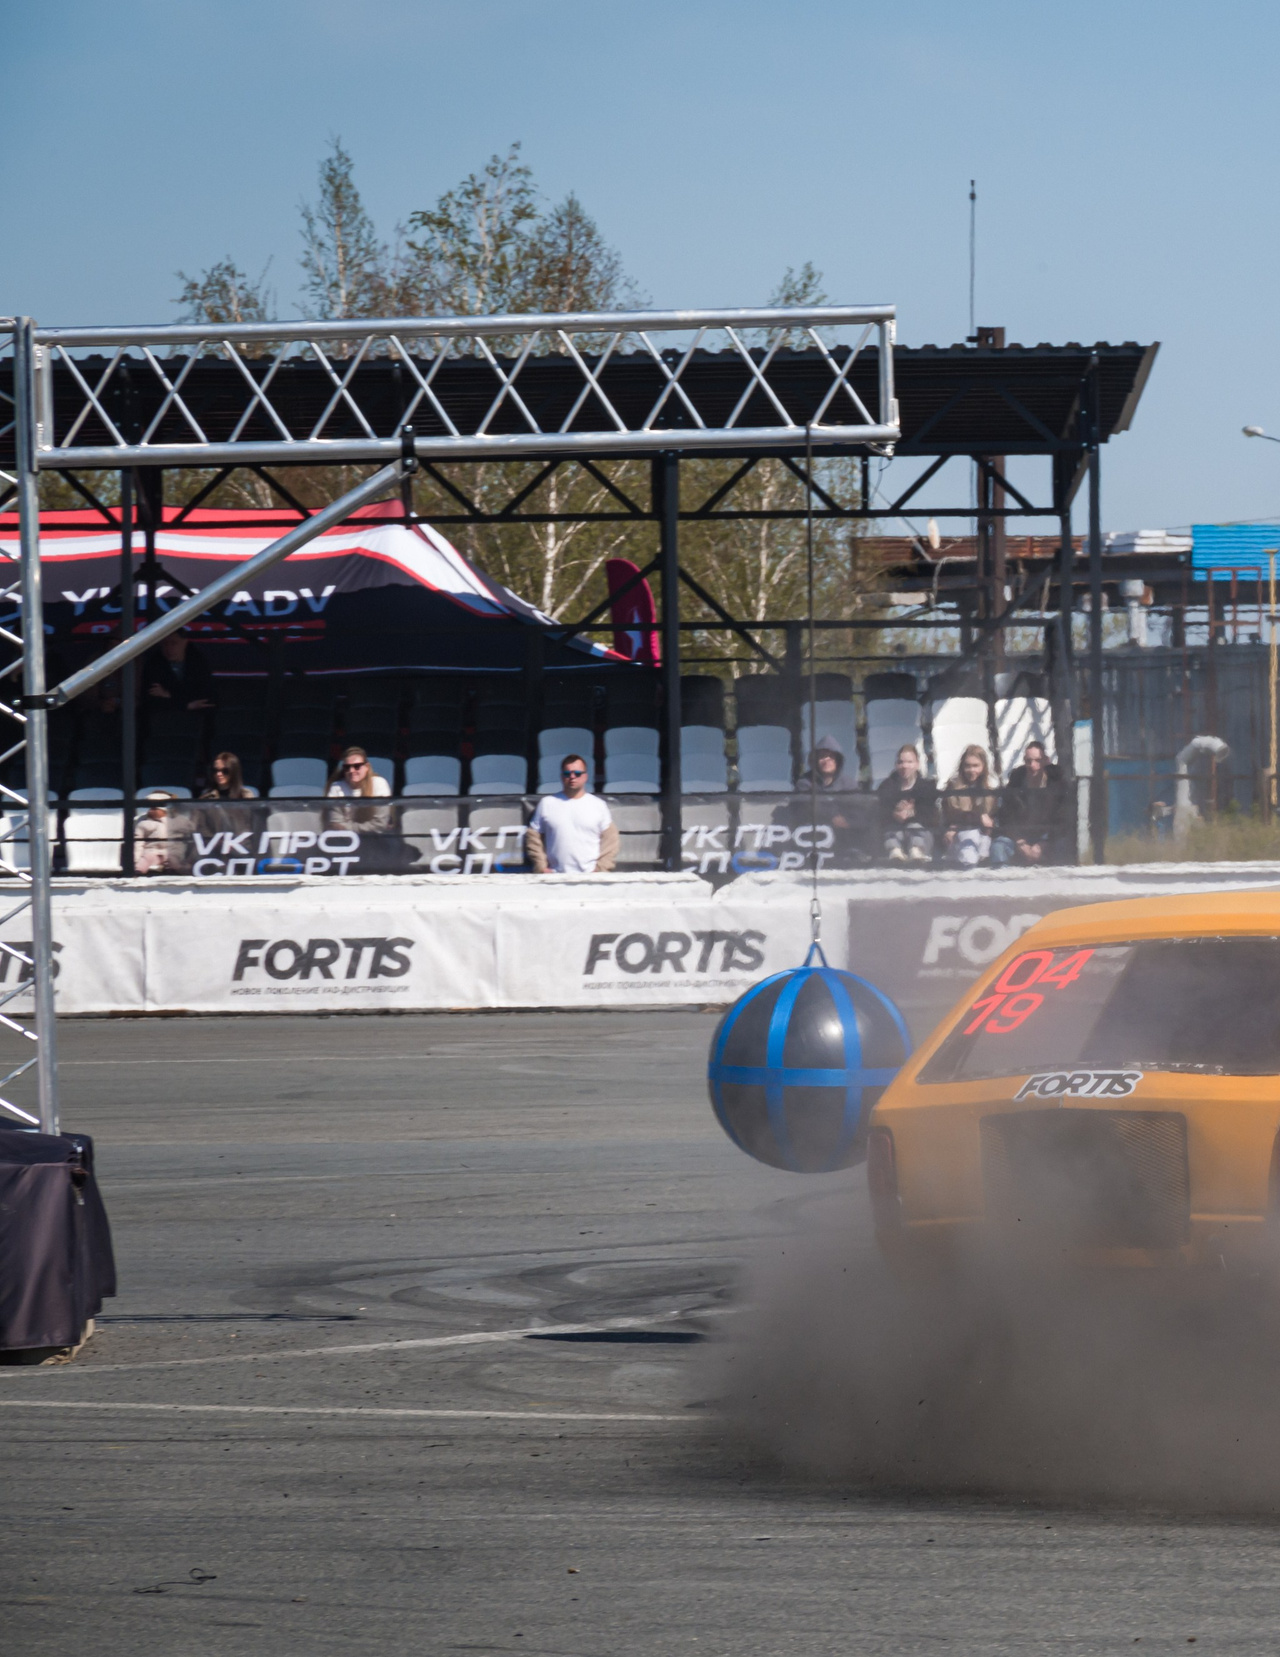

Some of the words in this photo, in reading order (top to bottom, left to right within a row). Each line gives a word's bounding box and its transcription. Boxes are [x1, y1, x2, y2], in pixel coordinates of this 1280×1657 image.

[224, 585, 336, 617] ADV
[192, 831, 253, 855] VK
[258, 830, 360, 854] ПРО
[429, 826, 491, 850] VK
[734, 824, 835, 848] ПРО
[192, 856, 360, 877] СПОРТ
[430, 853, 536, 874] СПО
[232, 937, 415, 981] FORTIS
[583, 930, 766, 975] FORTIS
[995, 949, 1096, 993] 04
[963, 993, 1045, 1035] 19
[1015, 1072, 1141, 1099] FORTIS
